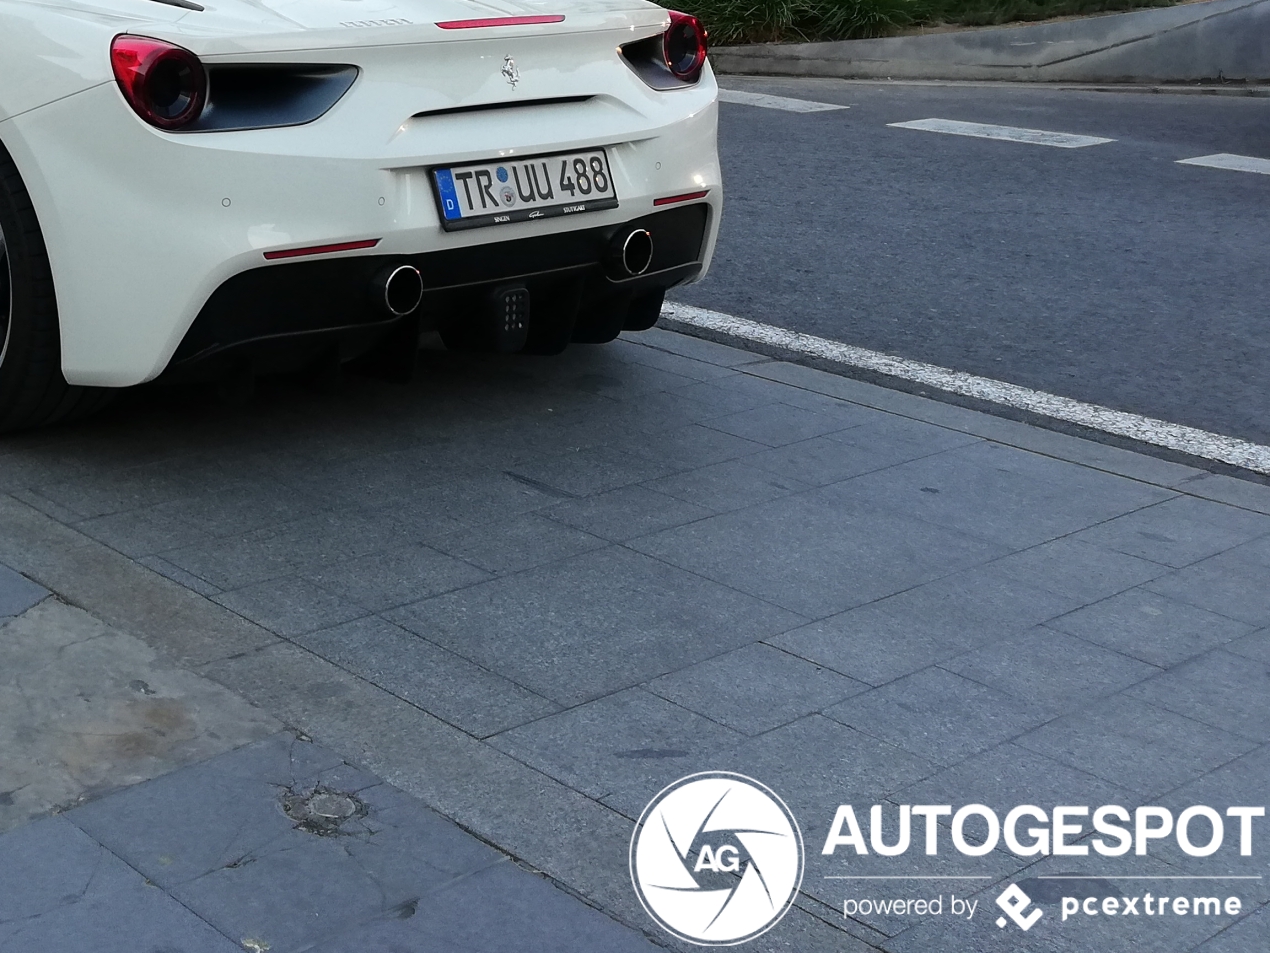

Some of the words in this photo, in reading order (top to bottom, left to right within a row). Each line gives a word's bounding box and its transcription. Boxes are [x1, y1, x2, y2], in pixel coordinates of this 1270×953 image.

[454, 169, 500, 210] TR
[511, 162, 555, 203] UU
[559, 156, 609, 197] 488
[493, 215, 511, 223] SINGEN
